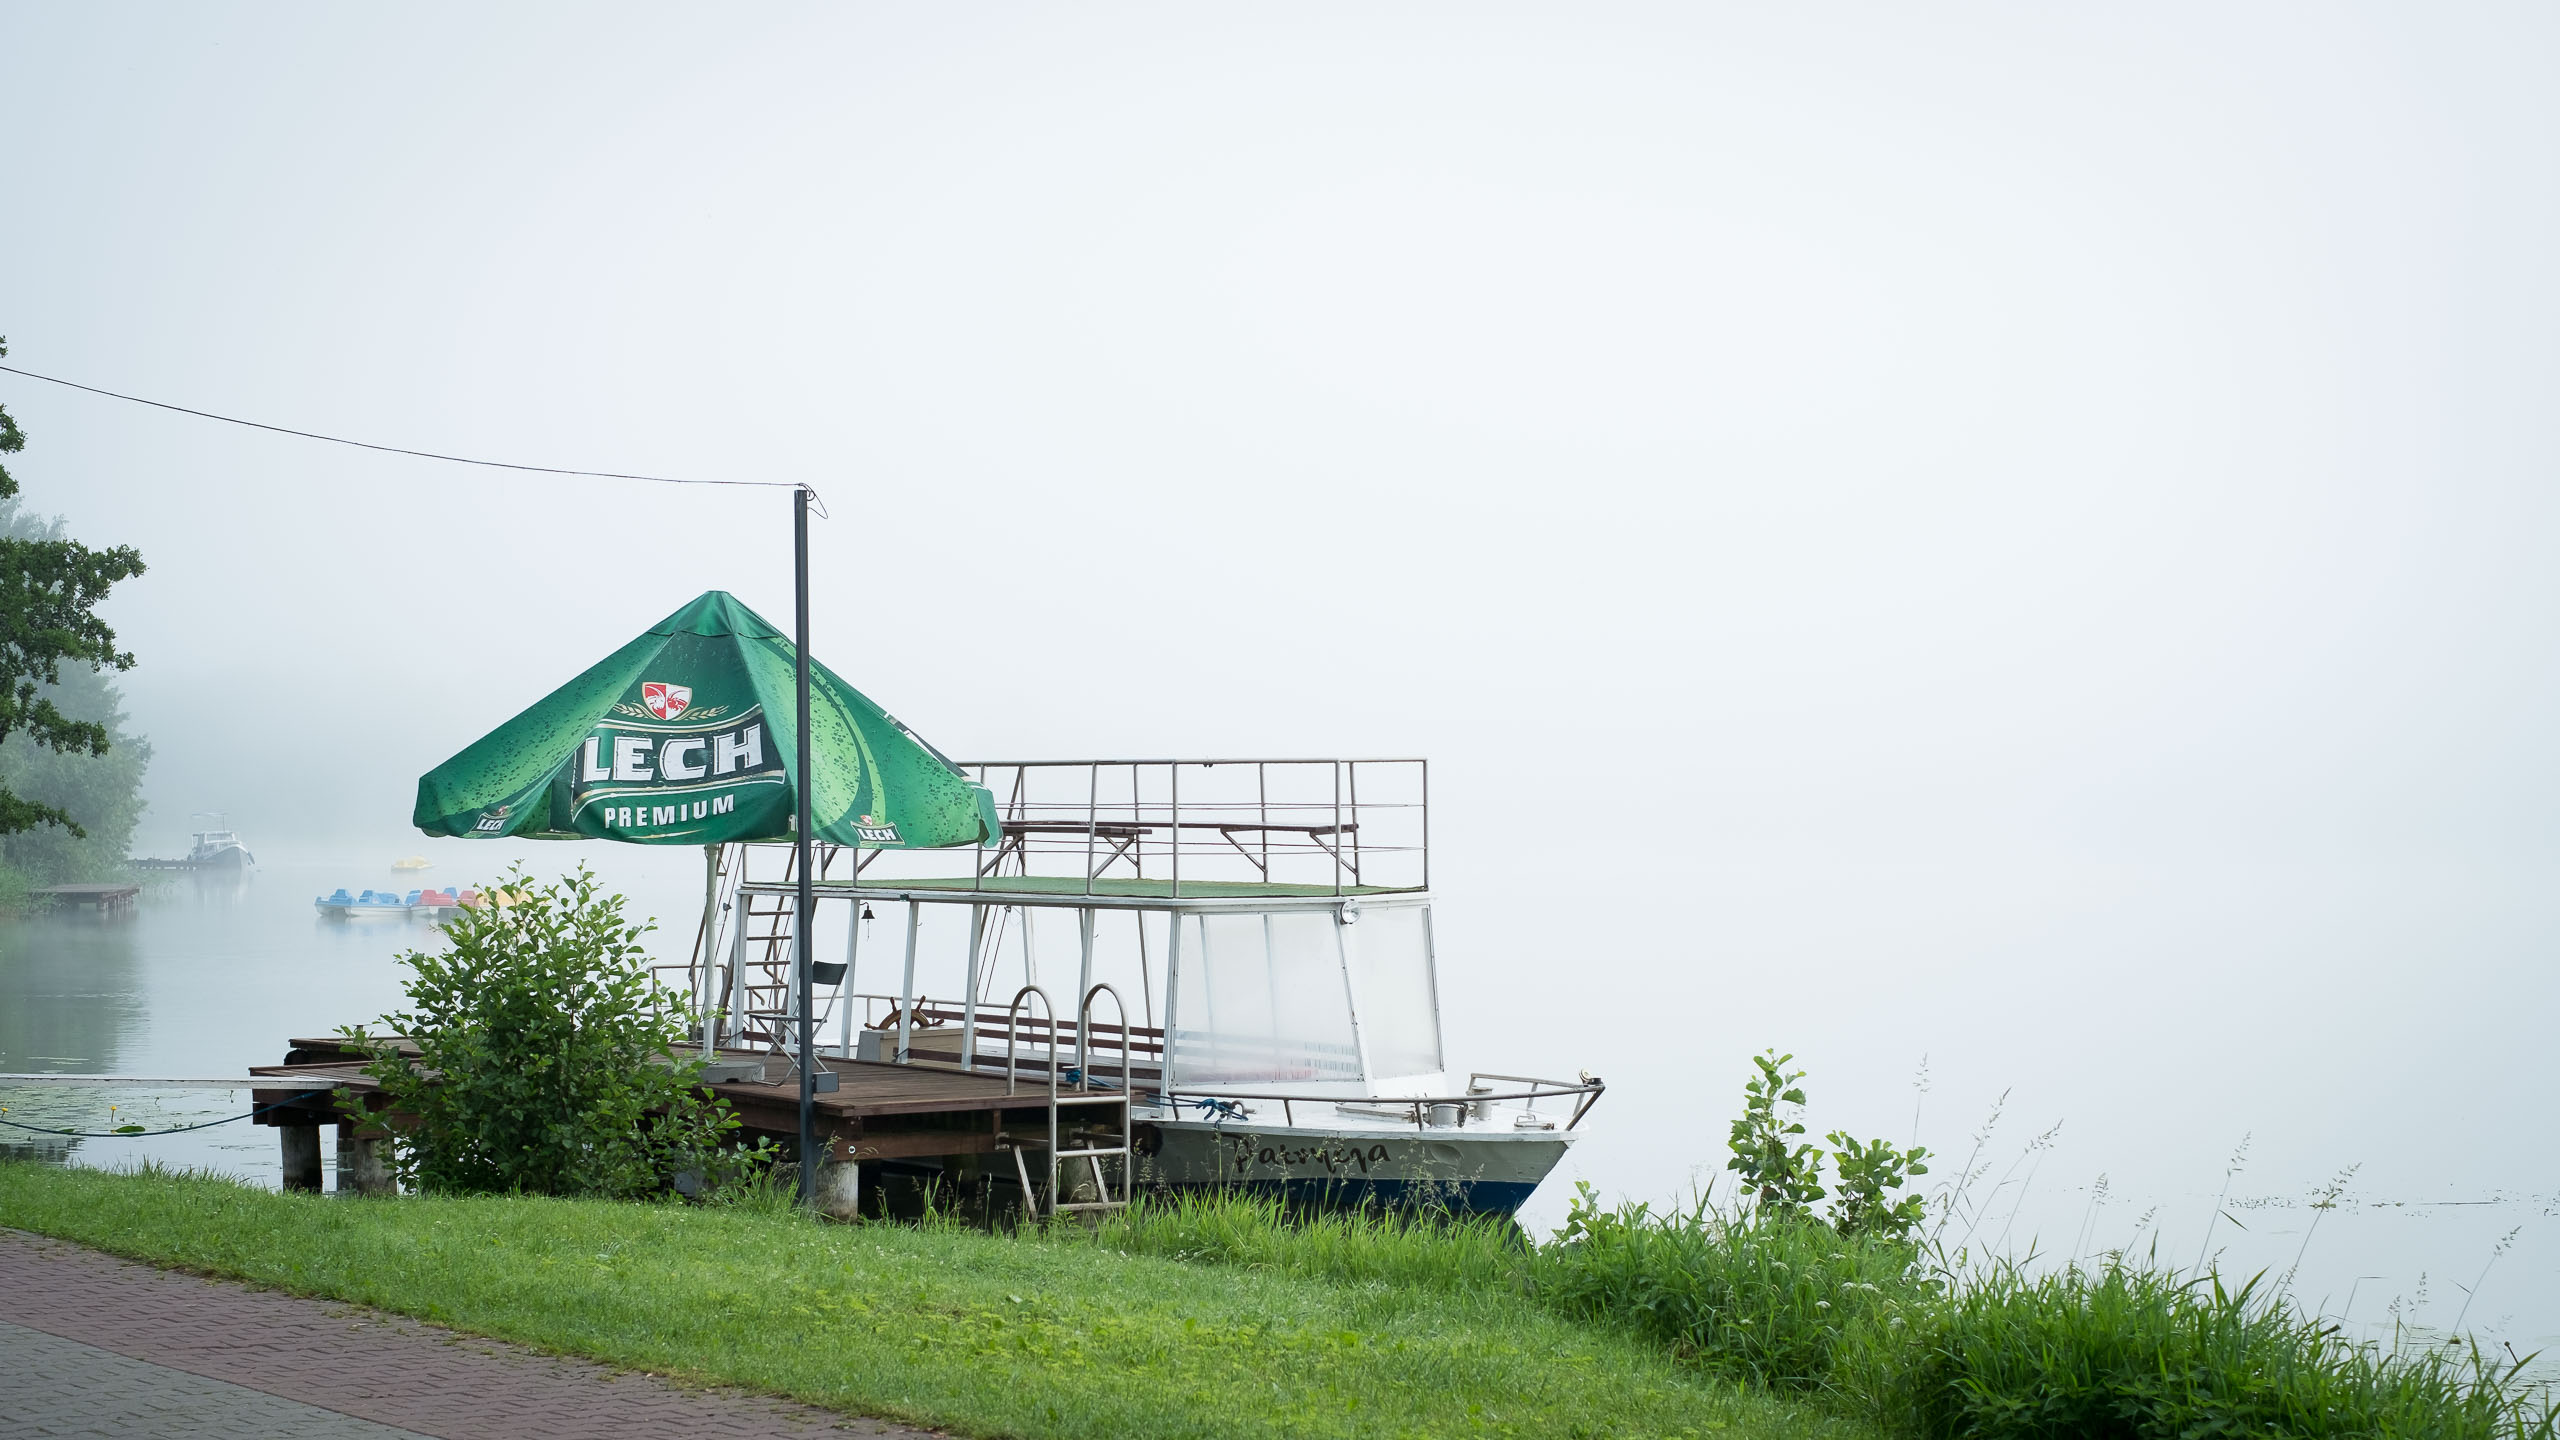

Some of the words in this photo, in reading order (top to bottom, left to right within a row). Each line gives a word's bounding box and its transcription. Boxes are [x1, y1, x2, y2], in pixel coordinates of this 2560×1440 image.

[583, 723, 763, 782] LECH
[604, 794, 735, 829] PREMIUM
[857, 828, 897, 841] LECH
